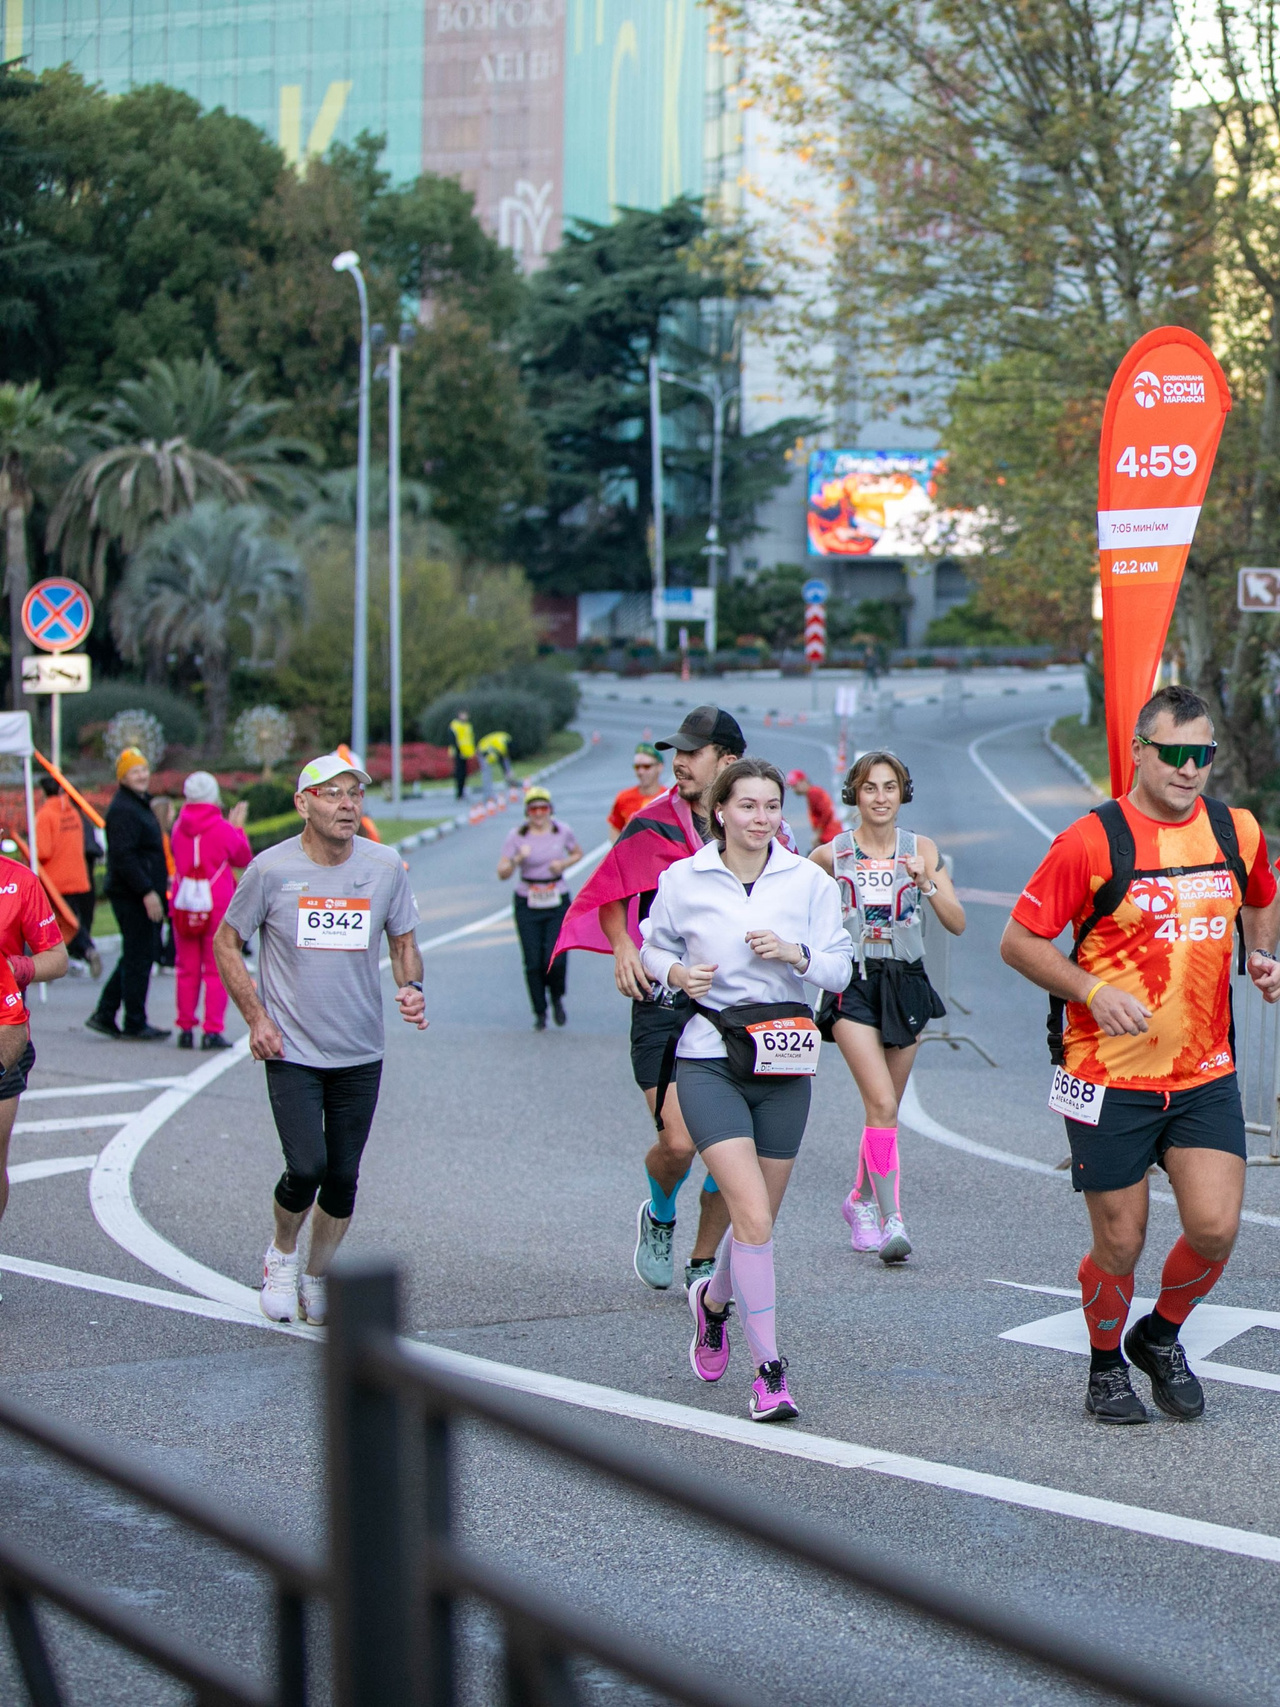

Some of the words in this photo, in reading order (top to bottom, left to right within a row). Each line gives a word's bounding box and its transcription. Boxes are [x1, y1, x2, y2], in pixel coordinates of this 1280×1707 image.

[1162, 382, 1205, 396] СОЧИ
[1163, 396, 1205, 404] МАРАФОН
[1116, 444, 1197, 478] 4:59
[1111, 523, 1132, 534] 7:05
[1133, 521, 1169, 533] мин/км
[1112, 560, 1138, 574] 42.2
[1177, 877, 1232, 893] СОЧИ
[1180, 890, 1233, 900] МАРАФОН
[308, 911, 363, 930] 6342
[1154, 916, 1227, 943] 4:59
[763, 1032, 814, 1052] 6324
[1055, 1070, 1096, 1103] 6668
